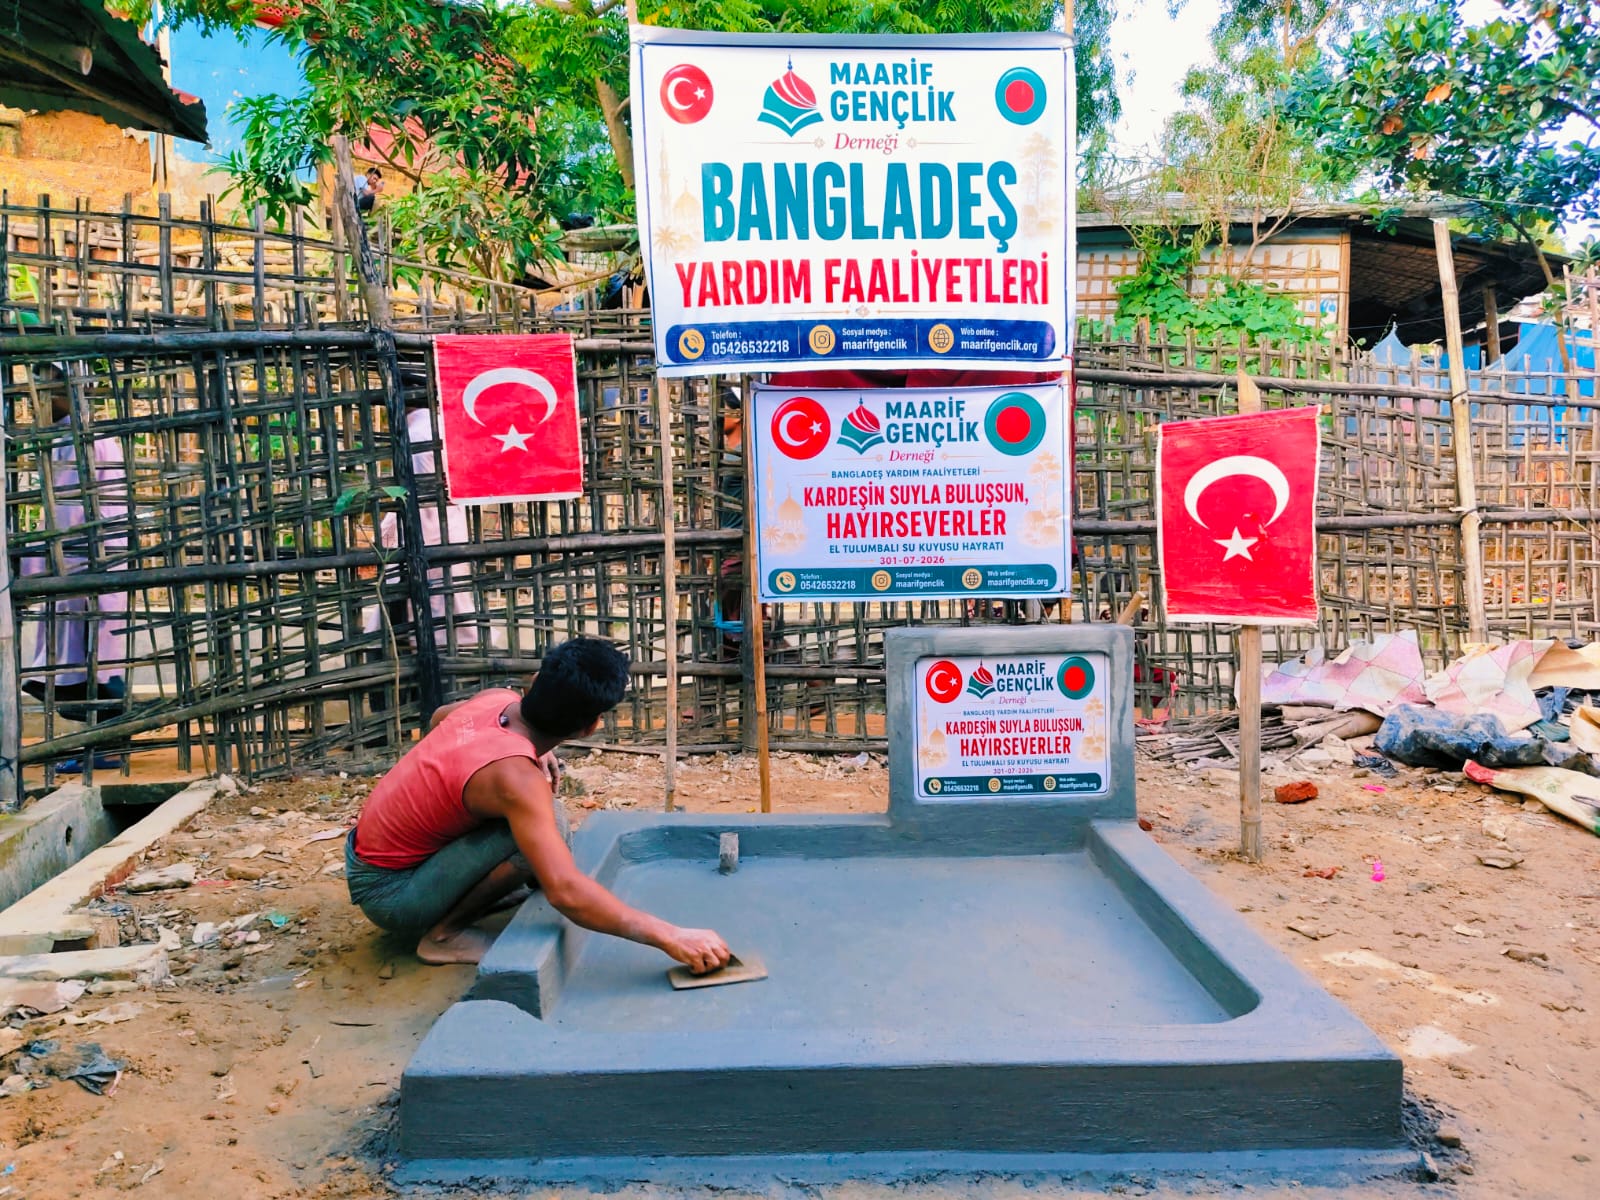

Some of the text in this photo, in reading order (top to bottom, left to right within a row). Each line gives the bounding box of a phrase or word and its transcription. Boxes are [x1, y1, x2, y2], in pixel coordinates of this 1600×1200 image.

[830, 57, 933, 86] MAARİF
[830, 85, 957, 129] GENÇLİK
[834, 132, 899, 155] Derneği
[701, 160, 1018, 253] BANGLADEŞ
[675, 249, 1049, 308] YARDIM FAALİYETLERİ
[842, 327, 864, 337] Sosyal
[960, 327, 975, 336] Web
[712, 340, 790, 355] 05426532218
[842, 338, 908, 352] maarifgenclik
[960, 338, 1038, 353] maarifgenclik.org
[885, 396, 966, 420] MAARİF
[885, 417, 980, 448] GENÇLİK
[889, 449, 935, 464] Derneği
[831, 466, 981, 480] BANGLADEŞ YARDIM FAALİYETLERİ
[803, 481, 1029, 510] KARDEŞİN SUYLA BULUŞSUN,
[827, 509, 1007, 539] HAYIRSEVERLER
[829, 541, 1004, 554] EL TULUMBALI SU KUYUSU HAYRATI
[879, 556, 945, 565] 301-07-2026
[800, 580, 856, 590] 05426532218
[895, 579, 945, 589] maarifgenclik
[987, 577, 1049, 588] maarifgenclik.org
[996, 660, 1046, 676] MAARİF
[996, 674, 1054, 695] GENÇLİK
[945, 717, 1085, 738] KARDEŞİN SUYLA BULUŞSUN,
[960, 735, 1071, 757] HAYIRSEVERLER
[970, 759, 1006, 767] TULUMBALI
